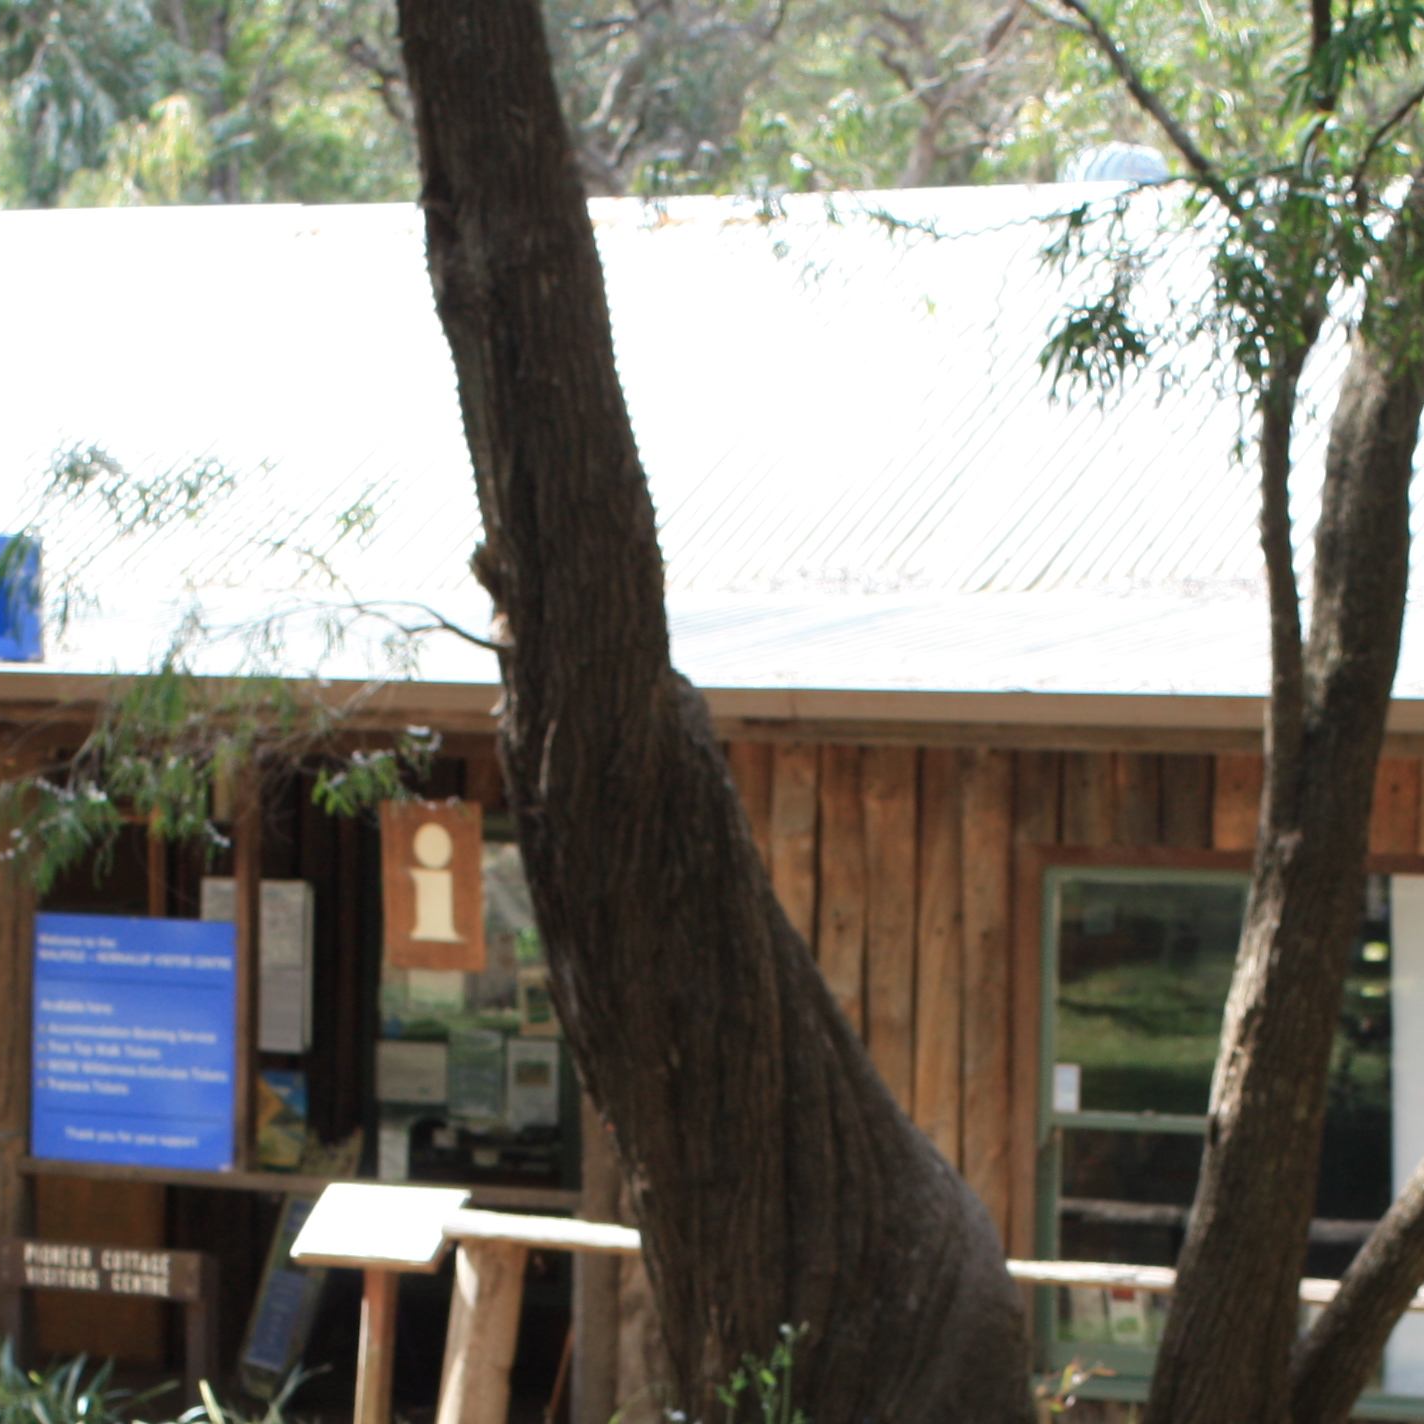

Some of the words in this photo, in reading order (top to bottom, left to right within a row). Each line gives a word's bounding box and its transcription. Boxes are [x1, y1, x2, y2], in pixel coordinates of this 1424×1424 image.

[23, 1243, 92, 1267] PIONEER
[100, 1249, 170, 1275] COTTAGE
[25, 1266, 100, 1290] VISITORS
[111, 1272, 170, 1297] CENTRE
